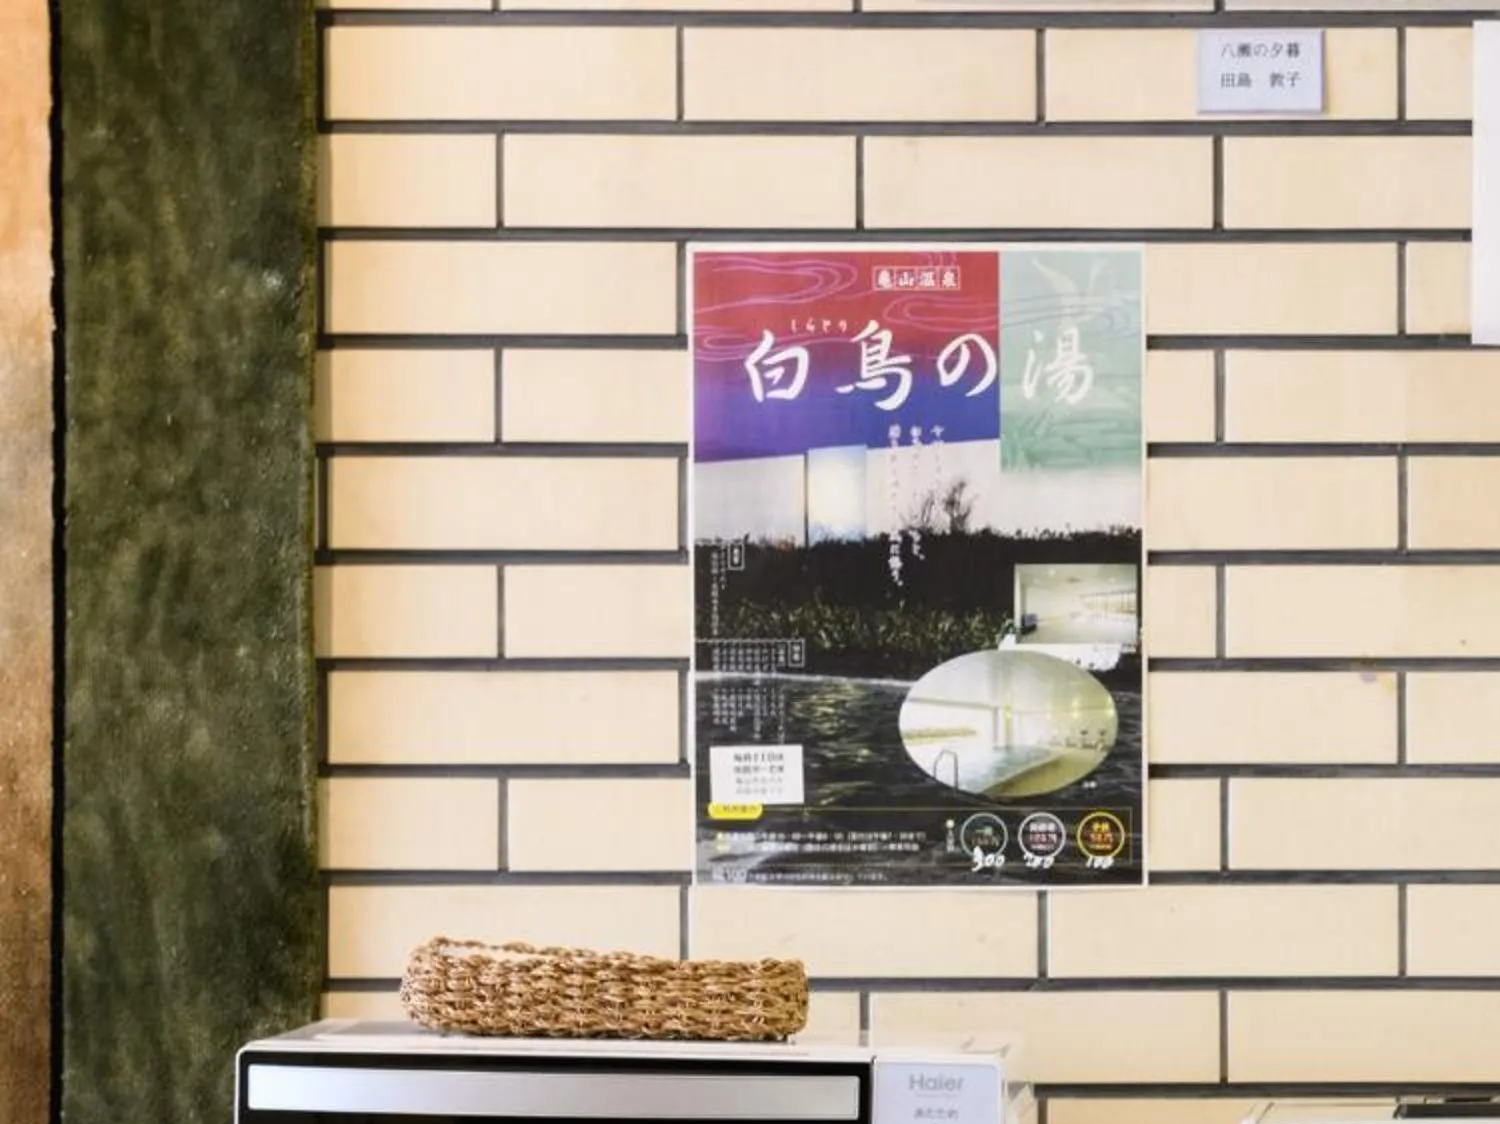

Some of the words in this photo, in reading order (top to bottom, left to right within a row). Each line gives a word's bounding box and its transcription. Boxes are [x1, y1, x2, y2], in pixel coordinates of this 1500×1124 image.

[1220, 72, 1251, 88] 田島
[876, 267, 959, 290] 亀山温泉
[789, 318, 849, 334] しらとり
[744, 319, 1094, 411] 白鳥の湯
[908, 1074, 966, 1091] Haier
